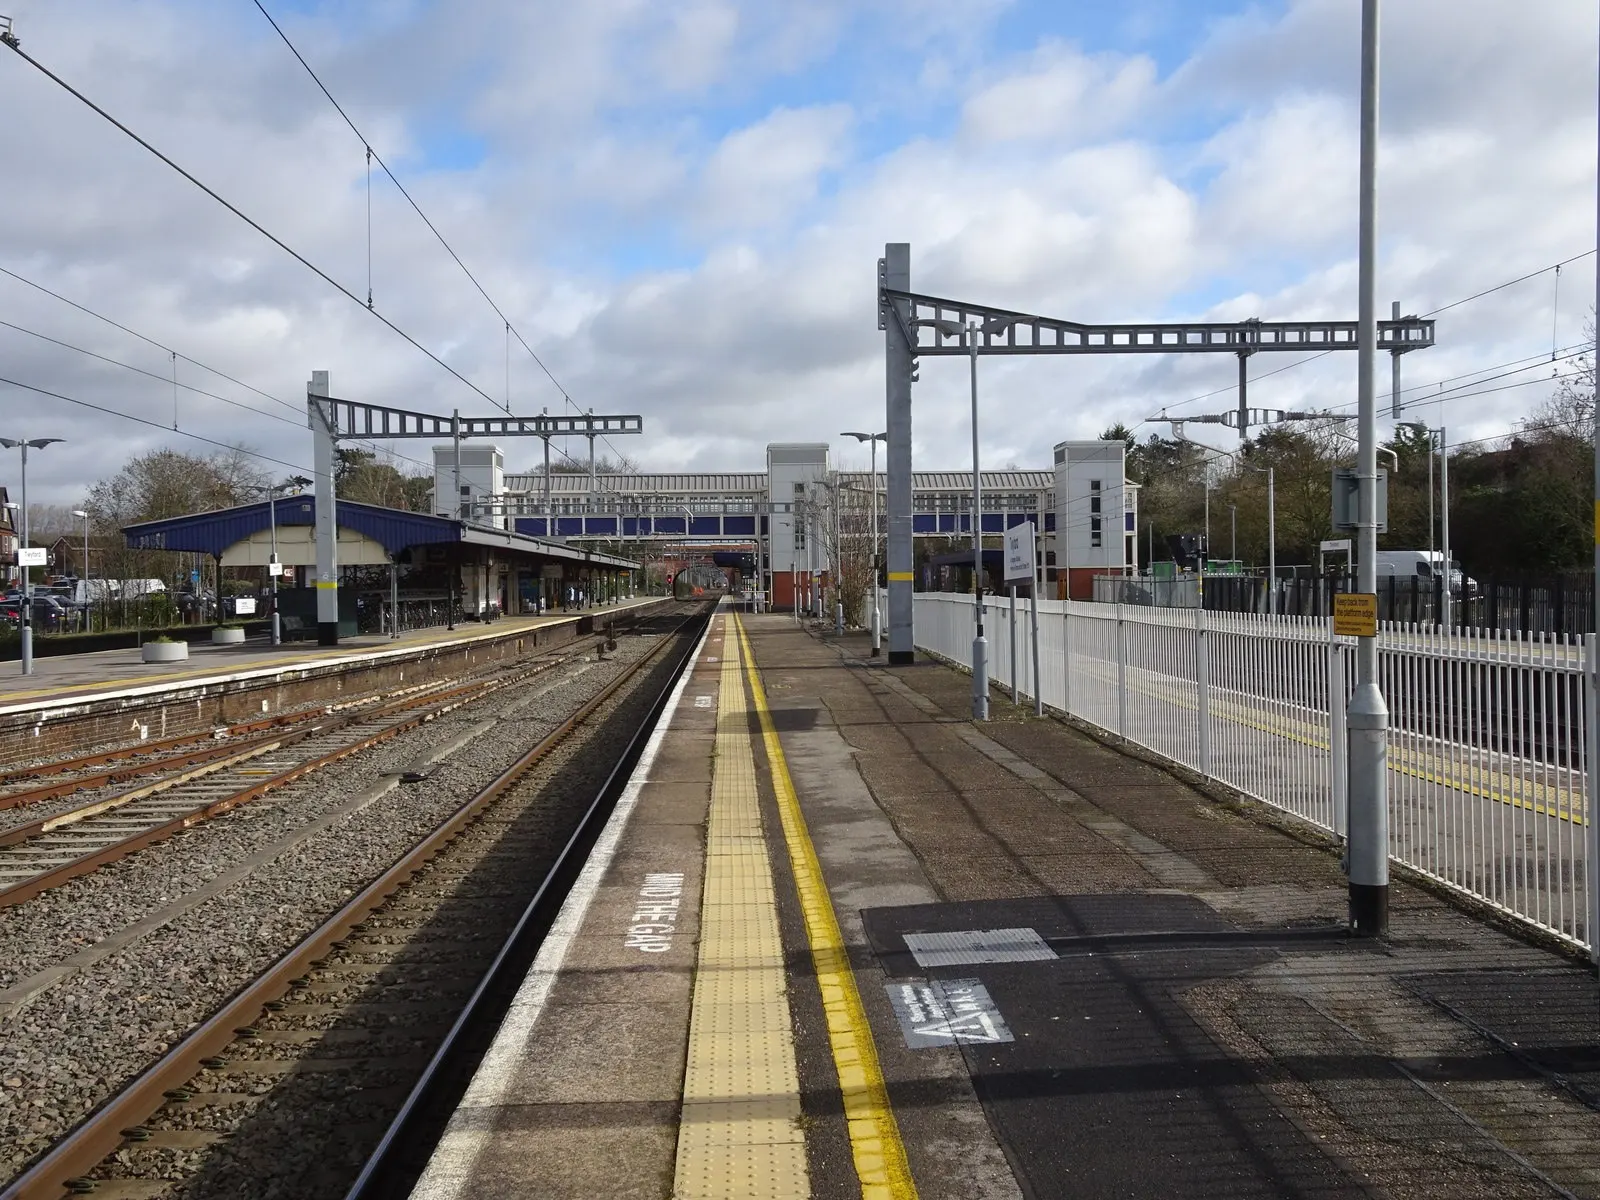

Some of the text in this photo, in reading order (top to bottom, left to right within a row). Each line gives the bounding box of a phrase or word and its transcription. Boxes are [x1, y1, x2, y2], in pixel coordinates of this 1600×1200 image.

[1337, 598, 1346, 607] Keep
[1347, 598, 1357, 606] back
[1344, 609, 1361, 617] platform
[1362, 609, 1374, 620] edge
[623, 872, 685, 953] MIND THE GAP
